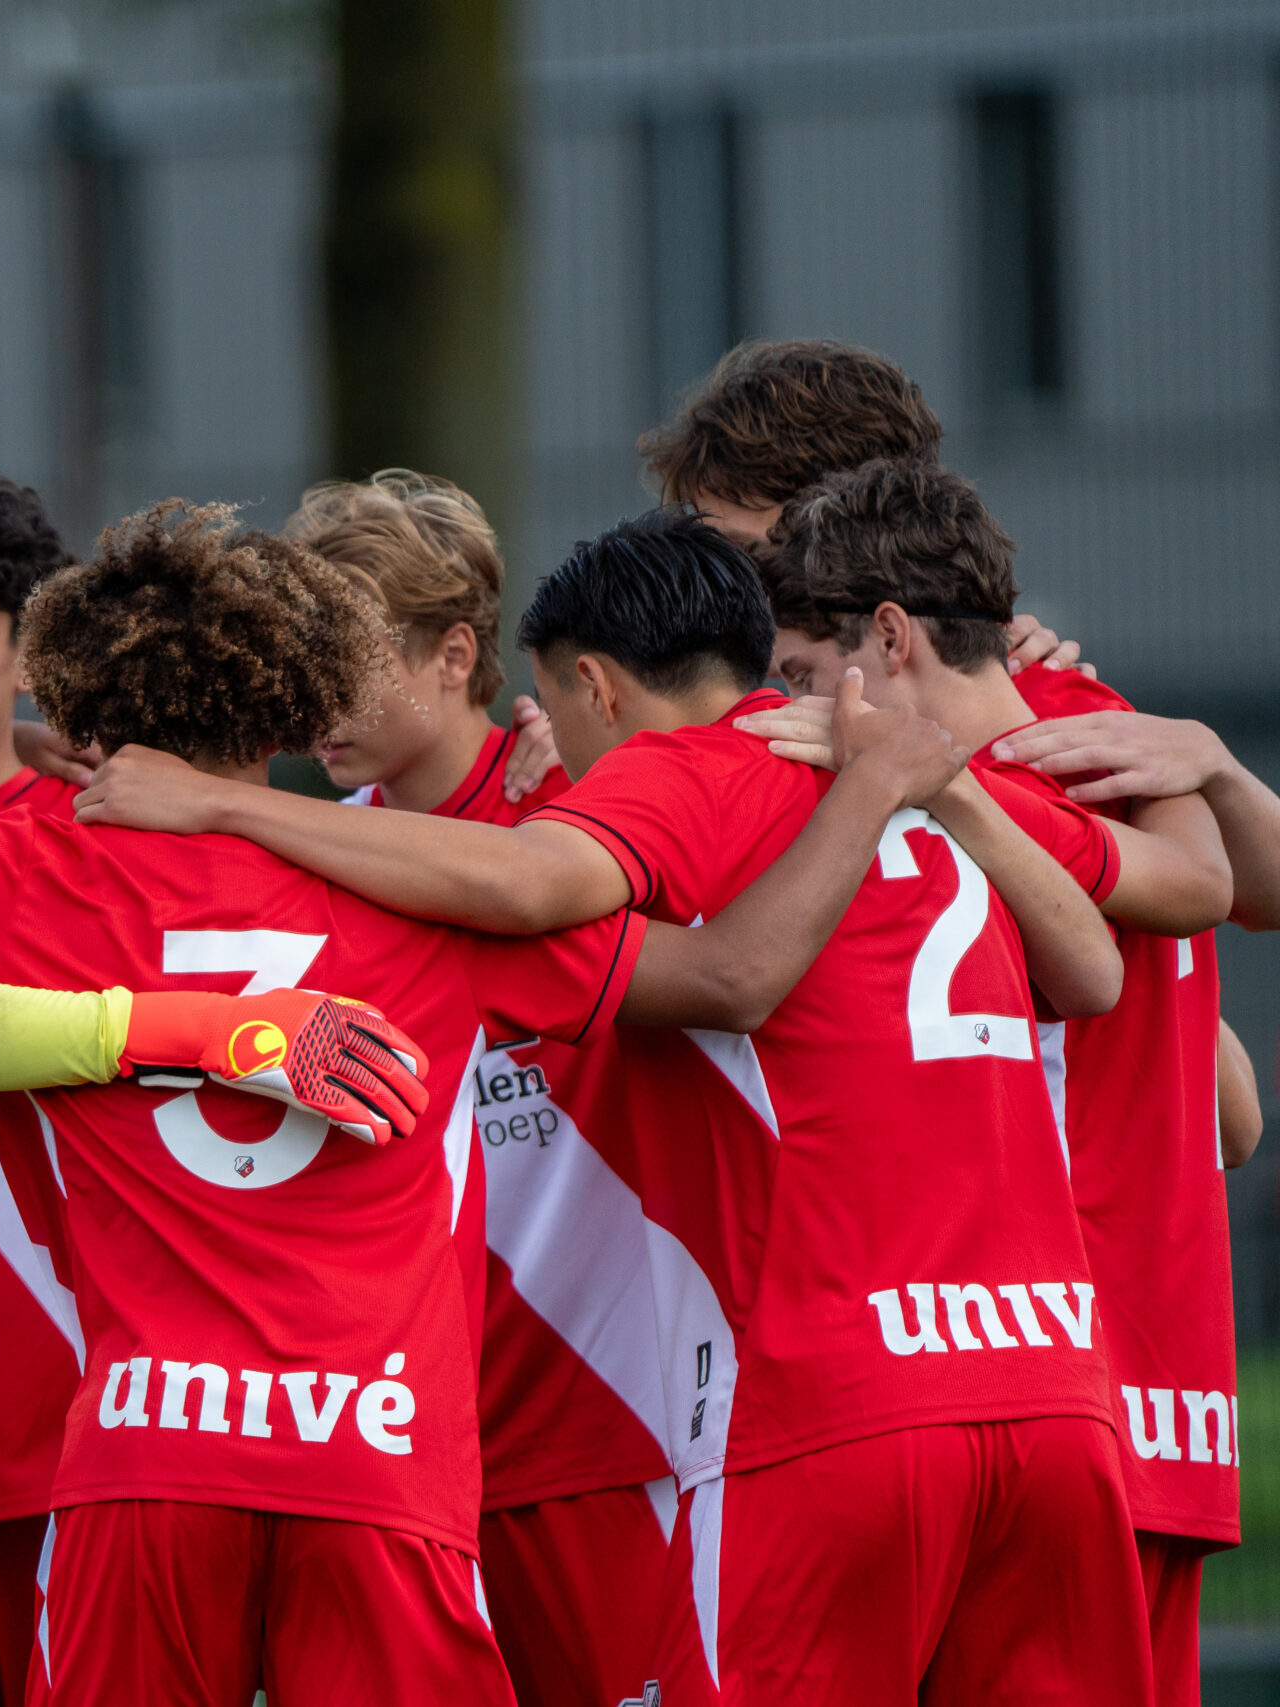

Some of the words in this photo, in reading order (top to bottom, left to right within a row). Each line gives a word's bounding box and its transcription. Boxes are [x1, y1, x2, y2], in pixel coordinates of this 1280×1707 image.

[878, 807, 1034, 1062] 2
[153, 930, 330, 1189] 3
[98, 1352, 416, 1455] univé
[868, 1281, 1101, 1356] univ
